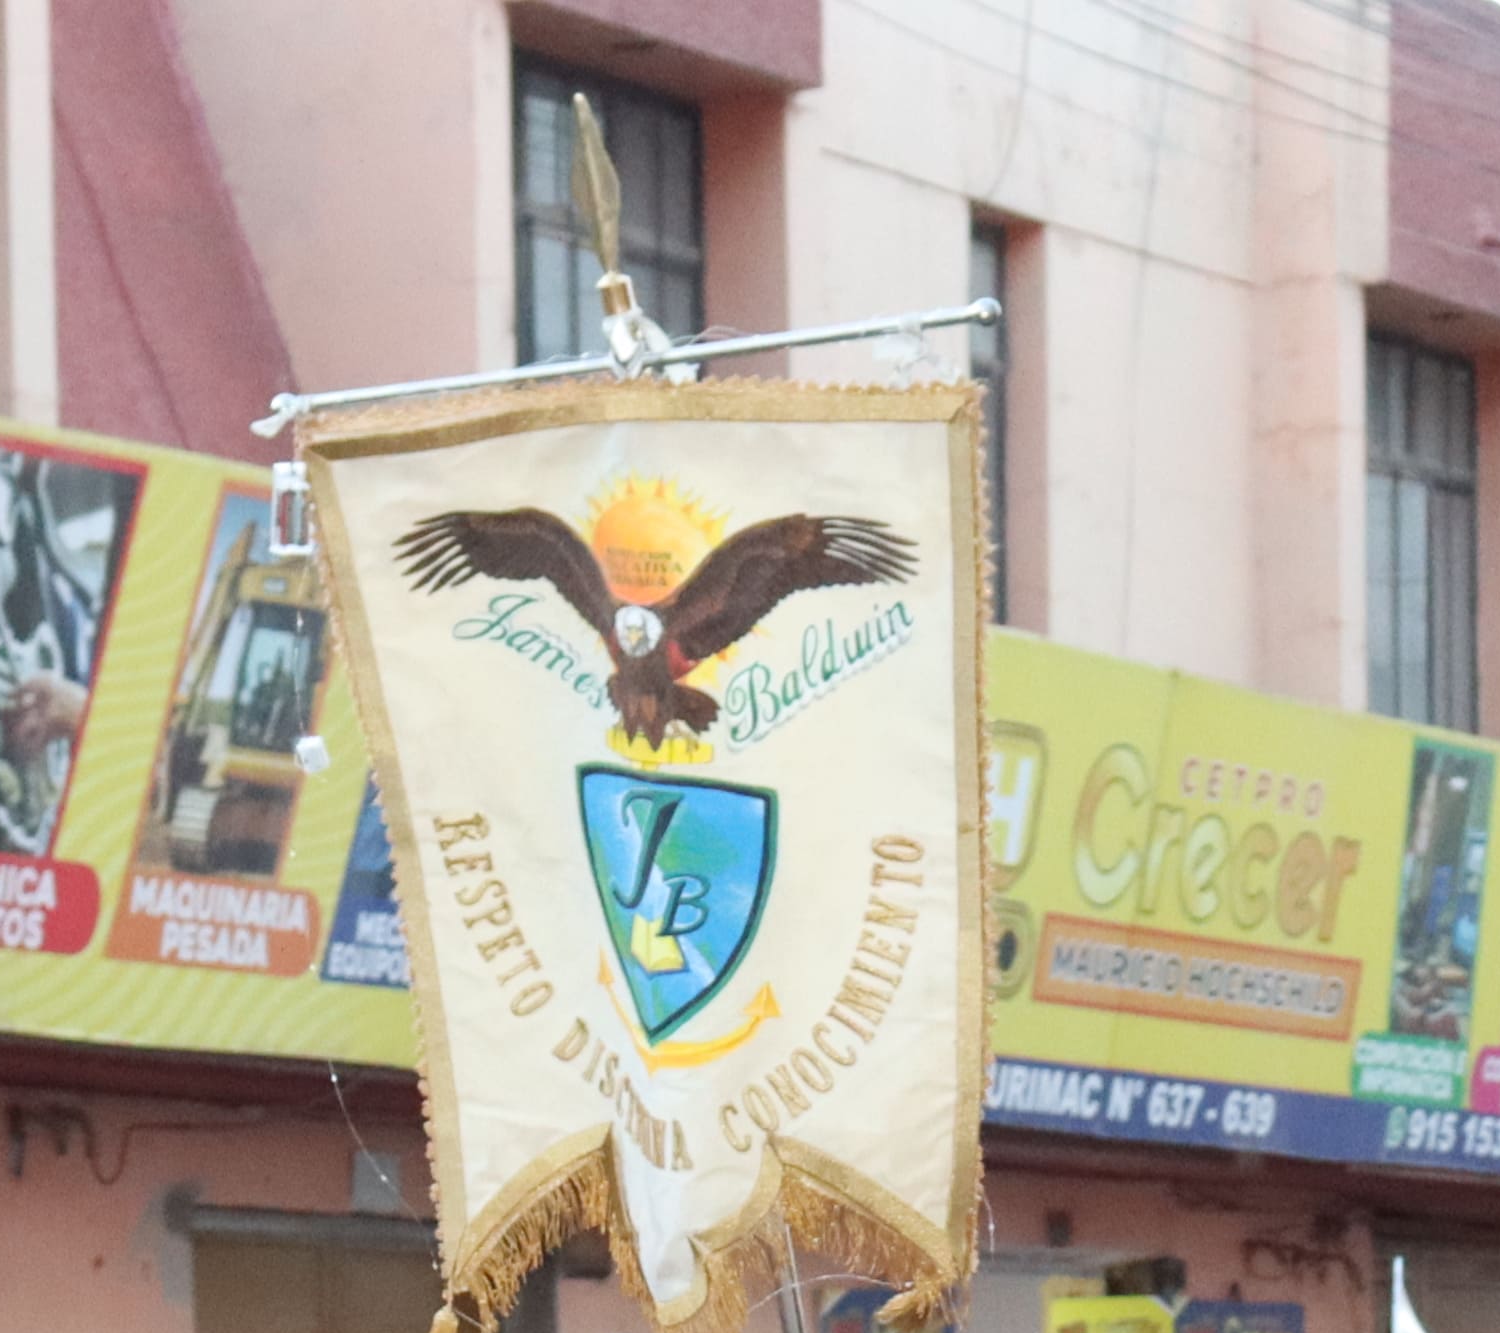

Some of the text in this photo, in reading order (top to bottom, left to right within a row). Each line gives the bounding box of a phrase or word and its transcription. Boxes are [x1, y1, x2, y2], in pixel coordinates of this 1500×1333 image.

[453, 593, 916, 746] James Baldwin
[1181, 757, 1327, 819] CETPRO
[1074, 742, 1362, 943] Crecer
[129, 874, 310, 932] MAQUINARIA
[159, 921, 270, 969] PESADA
[1049, 936, 1345, 1021] MAURICIO HOCHSCHILD
[431, 811, 555, 1018] RESPETO
[718, 833, 925, 1153] CONOCIMIENTO
[985, 1066, 1100, 1118] URIMAC
[1147, 1081, 1203, 1132] 637
[1220, 1089, 1275, 1137] 639
[1407, 1109, 1457, 1152] 915
